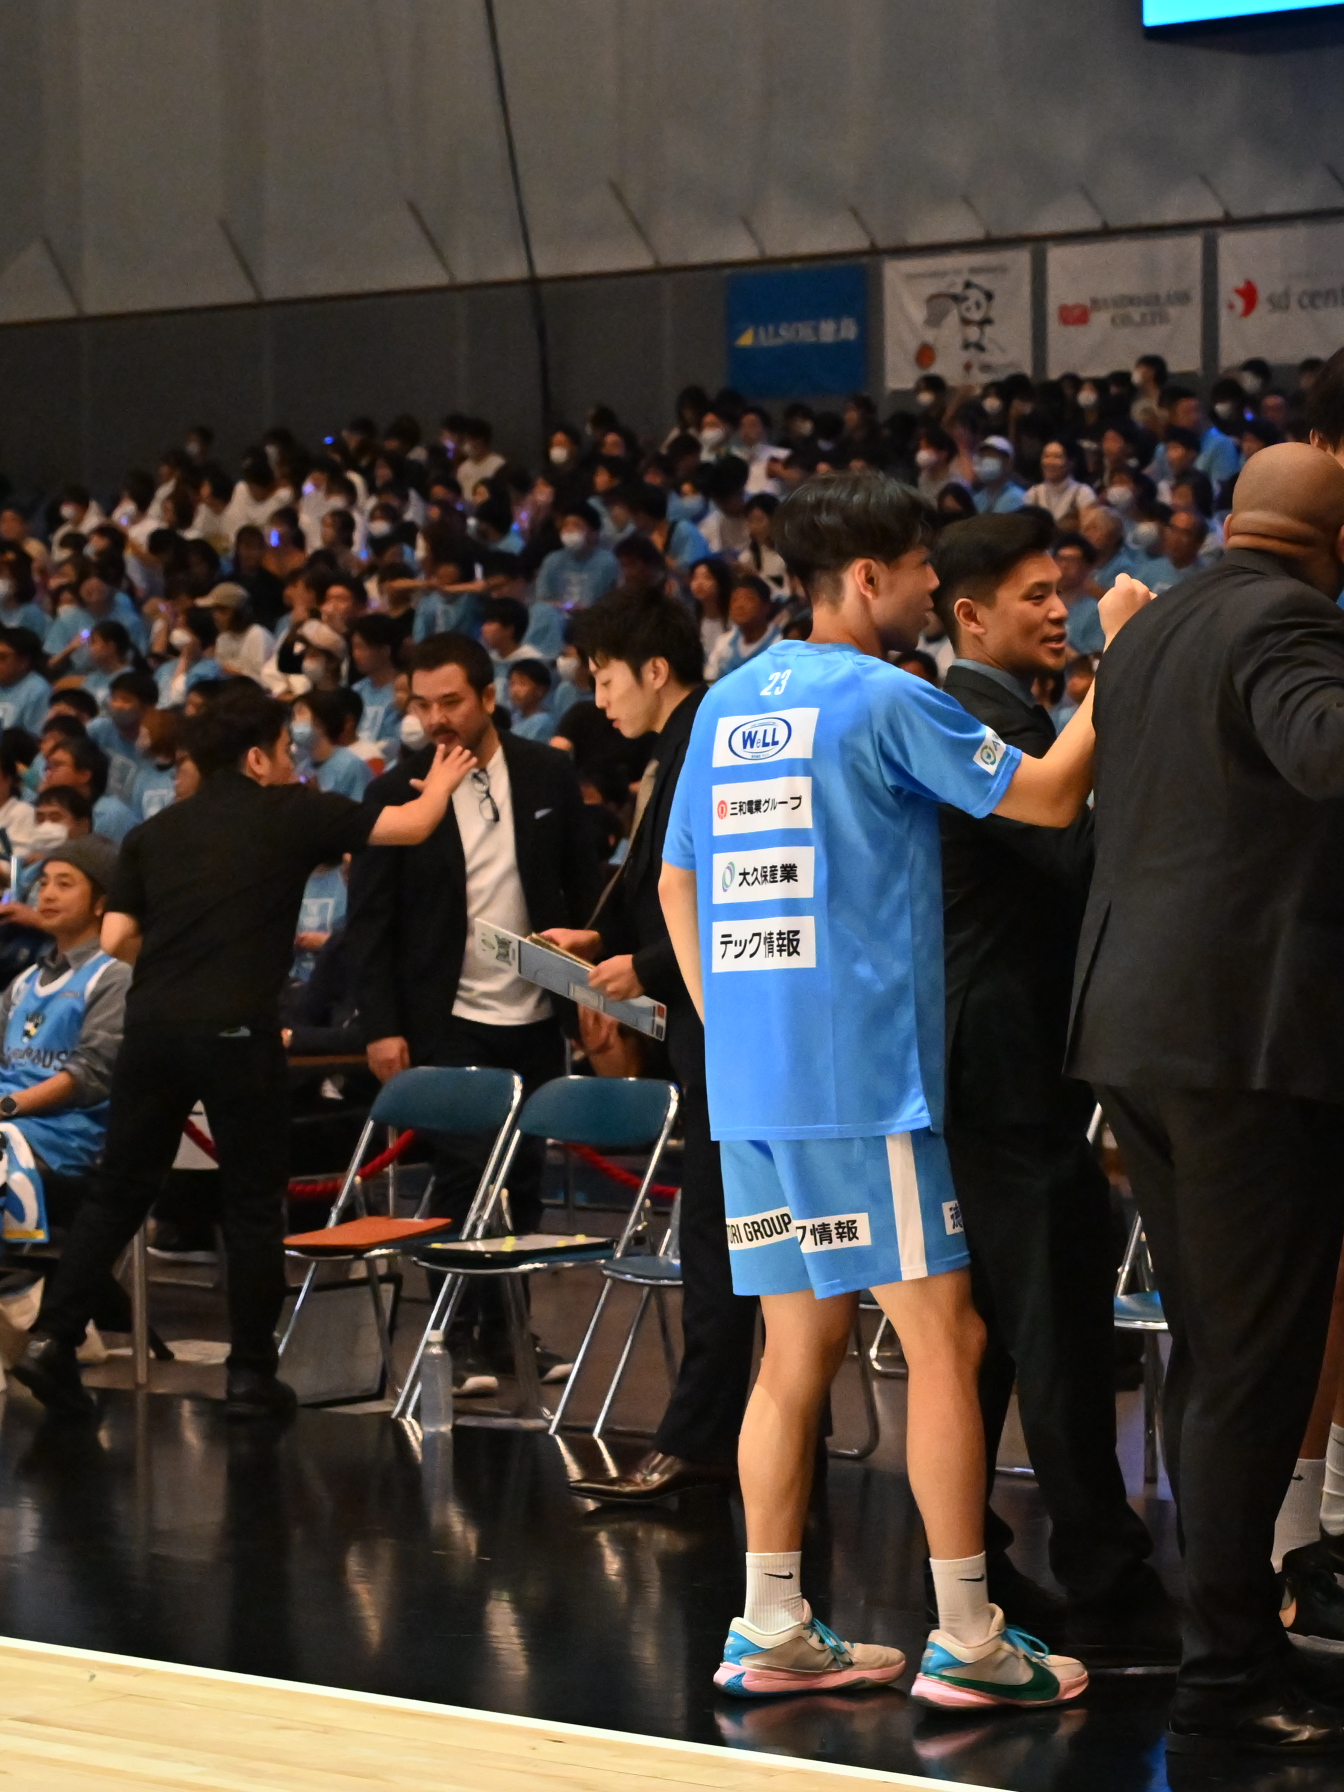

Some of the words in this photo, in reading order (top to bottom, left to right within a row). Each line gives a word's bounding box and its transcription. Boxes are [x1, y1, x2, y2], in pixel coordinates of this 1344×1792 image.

[760, 668, 792, 697] 23
[729, 794, 803, 818] 三和電業グループ
[738, 862, 799, 889] 大久保産業
[719, 929, 801, 961] テック情報
[743, 1212, 792, 1243] GROUP
